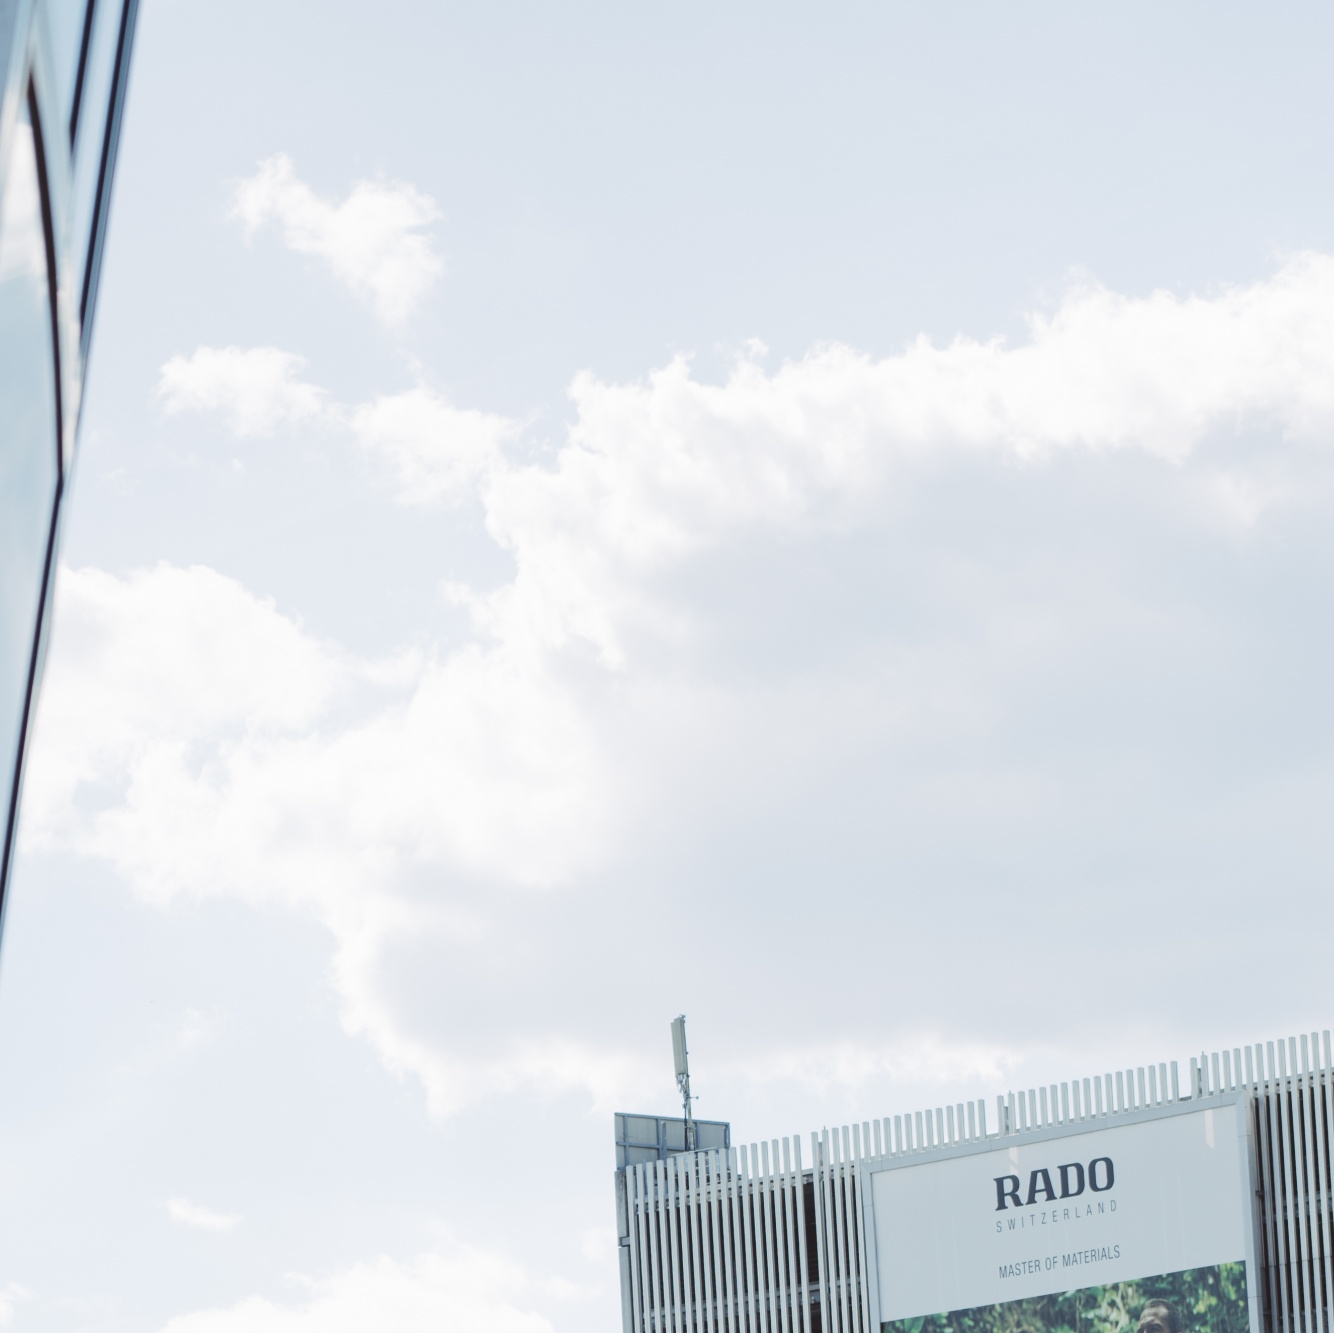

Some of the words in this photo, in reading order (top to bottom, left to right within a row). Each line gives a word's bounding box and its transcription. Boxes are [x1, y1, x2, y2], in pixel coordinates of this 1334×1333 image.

[993, 1157, 1115, 1211] RADO
[996, 1199, 1117, 1233] SWITZERLAND
[999, 1259, 1041, 1279] MASTER
[1045, 1256, 1058, 1271] OF
[1062, 1244, 1120, 1268] MATERIALS
